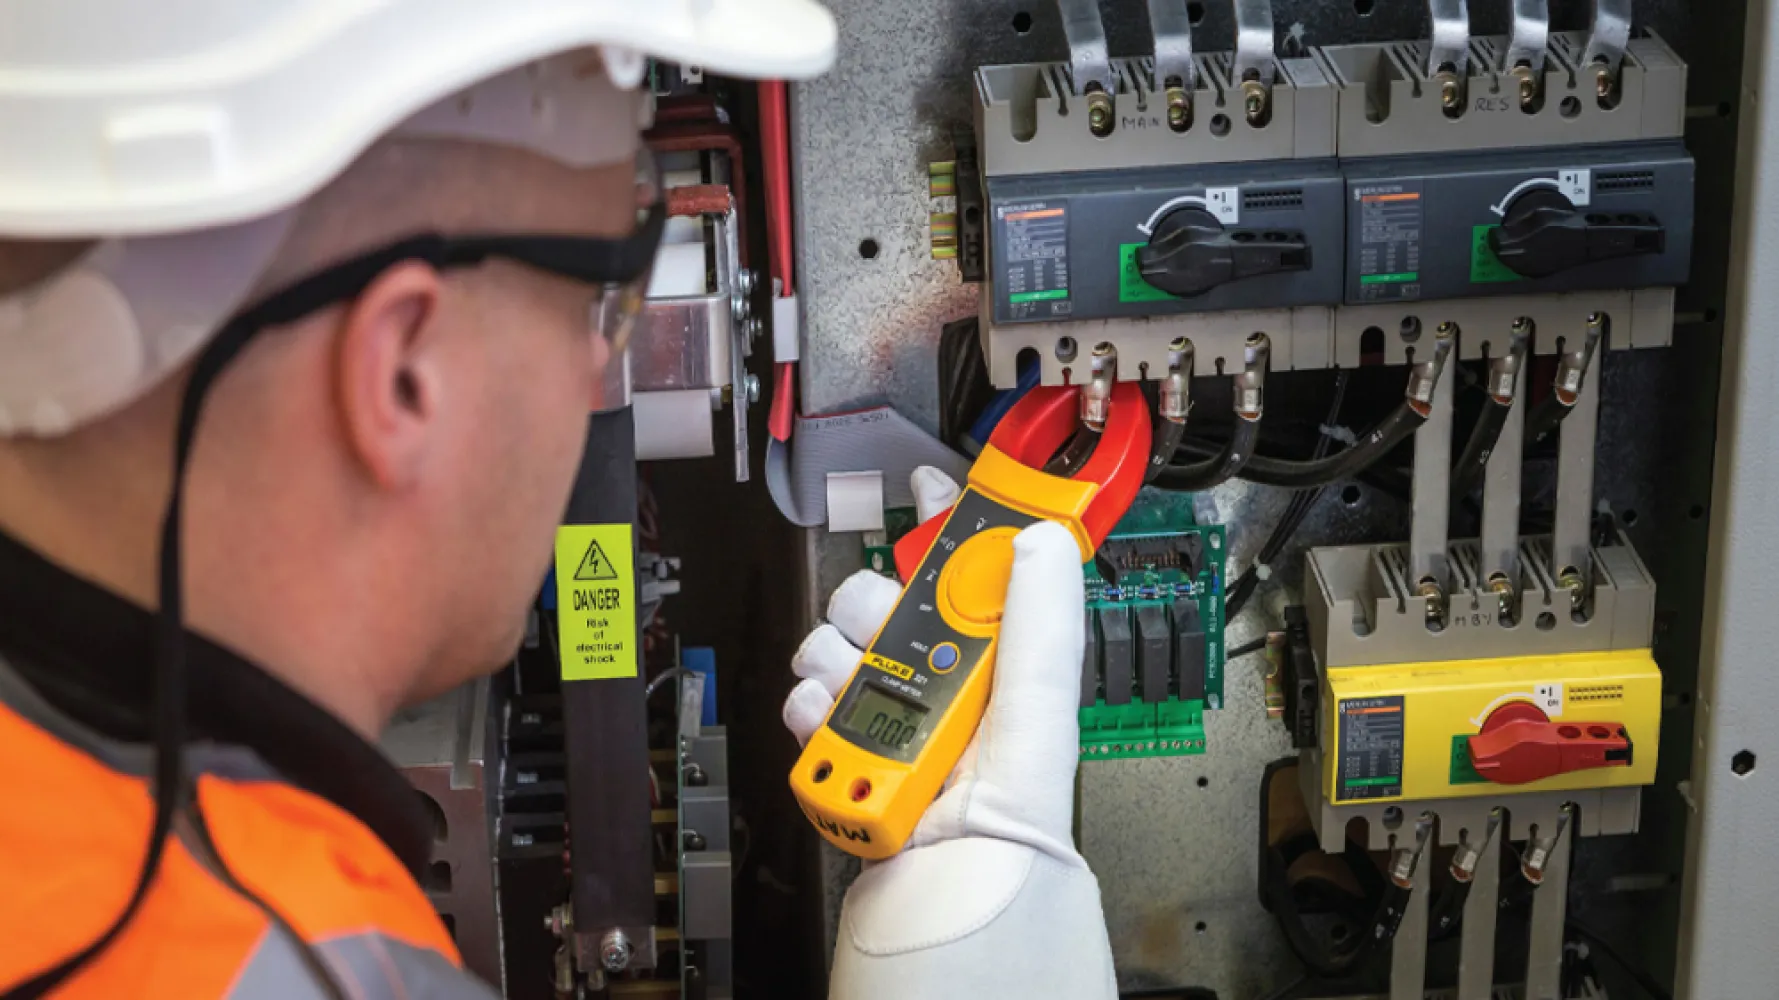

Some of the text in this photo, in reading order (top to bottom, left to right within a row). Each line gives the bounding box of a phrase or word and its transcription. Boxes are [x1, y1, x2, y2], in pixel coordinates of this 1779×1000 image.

[1474, 96, 1510, 112] RES
[1121, 115, 1160, 130] MAIN
[573, 587, 621, 611] DANGER
[586, 618, 609, 629] Risk
[594, 630, 604, 640] of
[576, 642, 623, 652] electrical
[583, 654, 616, 664] shock
[872, 657, 910, 676] FLUKE
